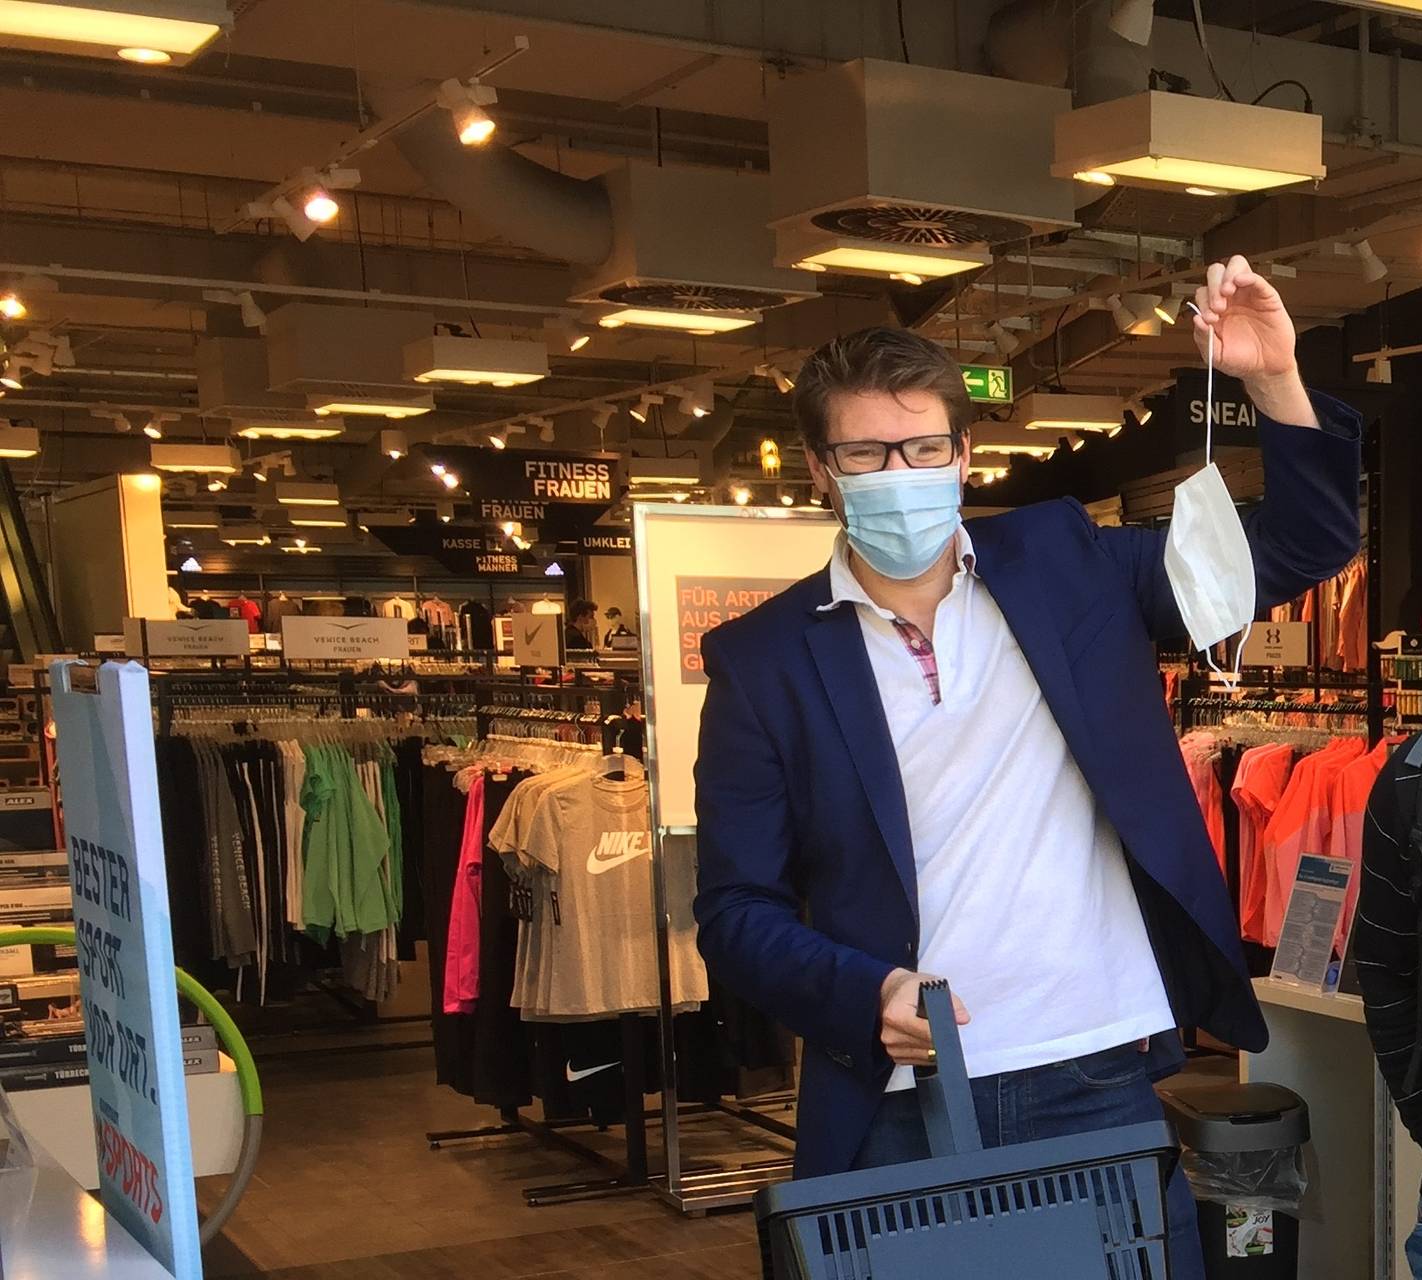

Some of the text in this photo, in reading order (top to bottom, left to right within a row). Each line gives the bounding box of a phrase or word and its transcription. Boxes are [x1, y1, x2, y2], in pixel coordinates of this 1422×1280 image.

[1190, 400, 1257, 427] SNEA
[525, 461, 610, 481] FITNESS
[534, 479, 611, 499] FRAUEN
[481, 504, 545, 519] FRAUEN
[442, 539, 481, 549] KASSE
[476, 555, 518, 564] FITNESS
[680, 585, 720, 607] FÜR
[682, 610, 721, 627] AUS
[597, 831, 644, 855] NIKE
[71, 835, 131, 922] BESTER
[78, 917, 126, 1000] SPORT
[85, 997, 157, 1105] VOR ORT.
[1253, 1214, 1271, 1225] JOY
